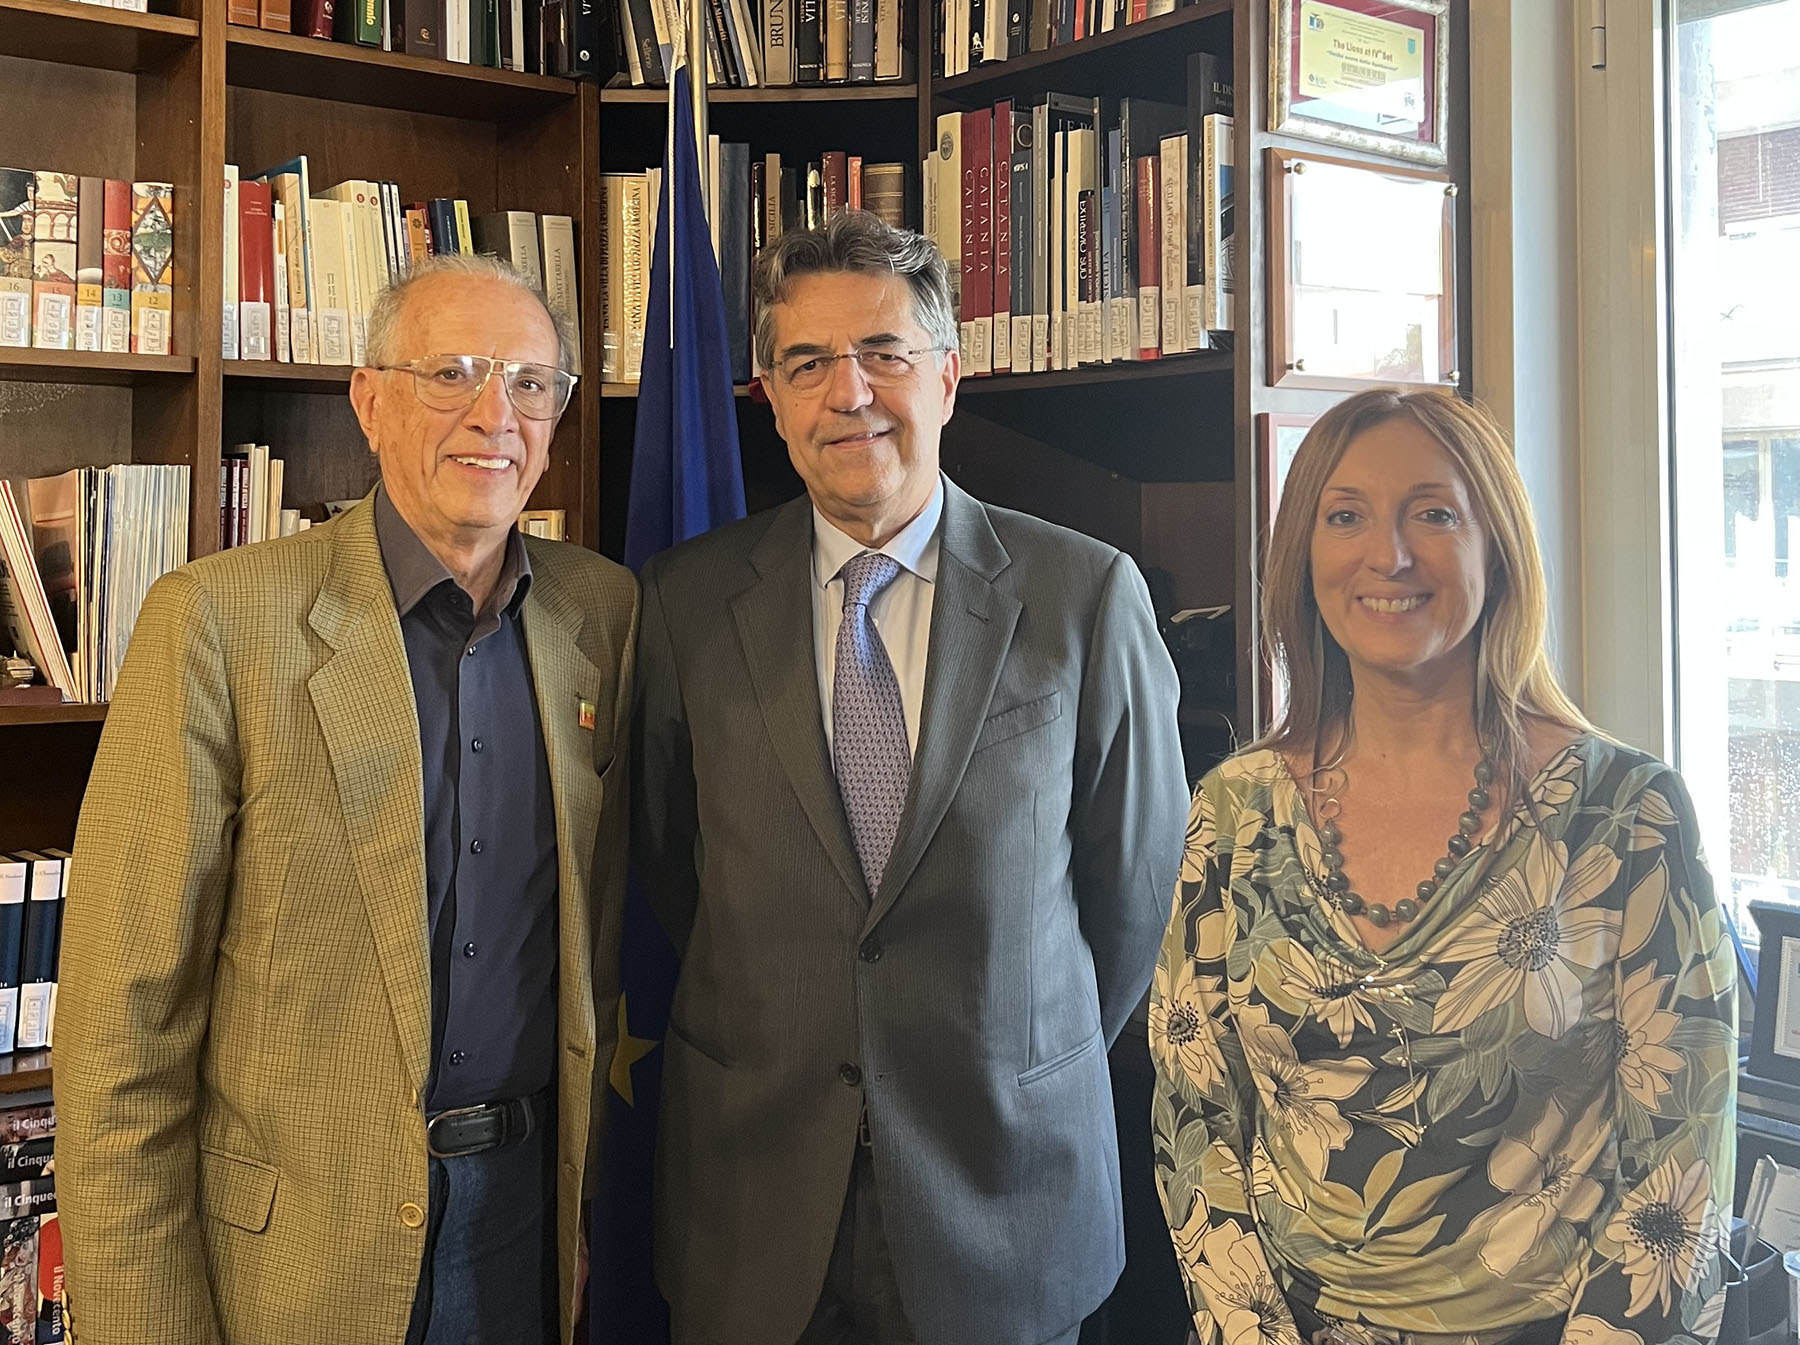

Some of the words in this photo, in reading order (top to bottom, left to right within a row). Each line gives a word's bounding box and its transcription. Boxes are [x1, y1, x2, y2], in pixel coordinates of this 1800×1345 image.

[770, 0, 784, 48] BRUN
[641, 38, 653, 69] Sellerio
[1333, 39, 1345, 50] The
[1346, 41, 1364, 55] Lions
[768, 196, 776, 231] SICILIA
[965, 169, 973, 273] CATANIA
[980, 167, 989, 272] CATANIA
[1000, 161, 1008, 274] CATANIA
[1079, 256, 1088, 280] SUD
[9, 282, 20, 291] 16
[112, 293, 122, 301] 13
[148, 296, 159, 305] 12
[12, 1119, 20, 1131] il
[7, 1157, 15, 1169] il
[4, 1196, 12, 1208] il
[12, 1283, 25, 1344] Novecento
[52, 1275, 63, 1336] Novecento
